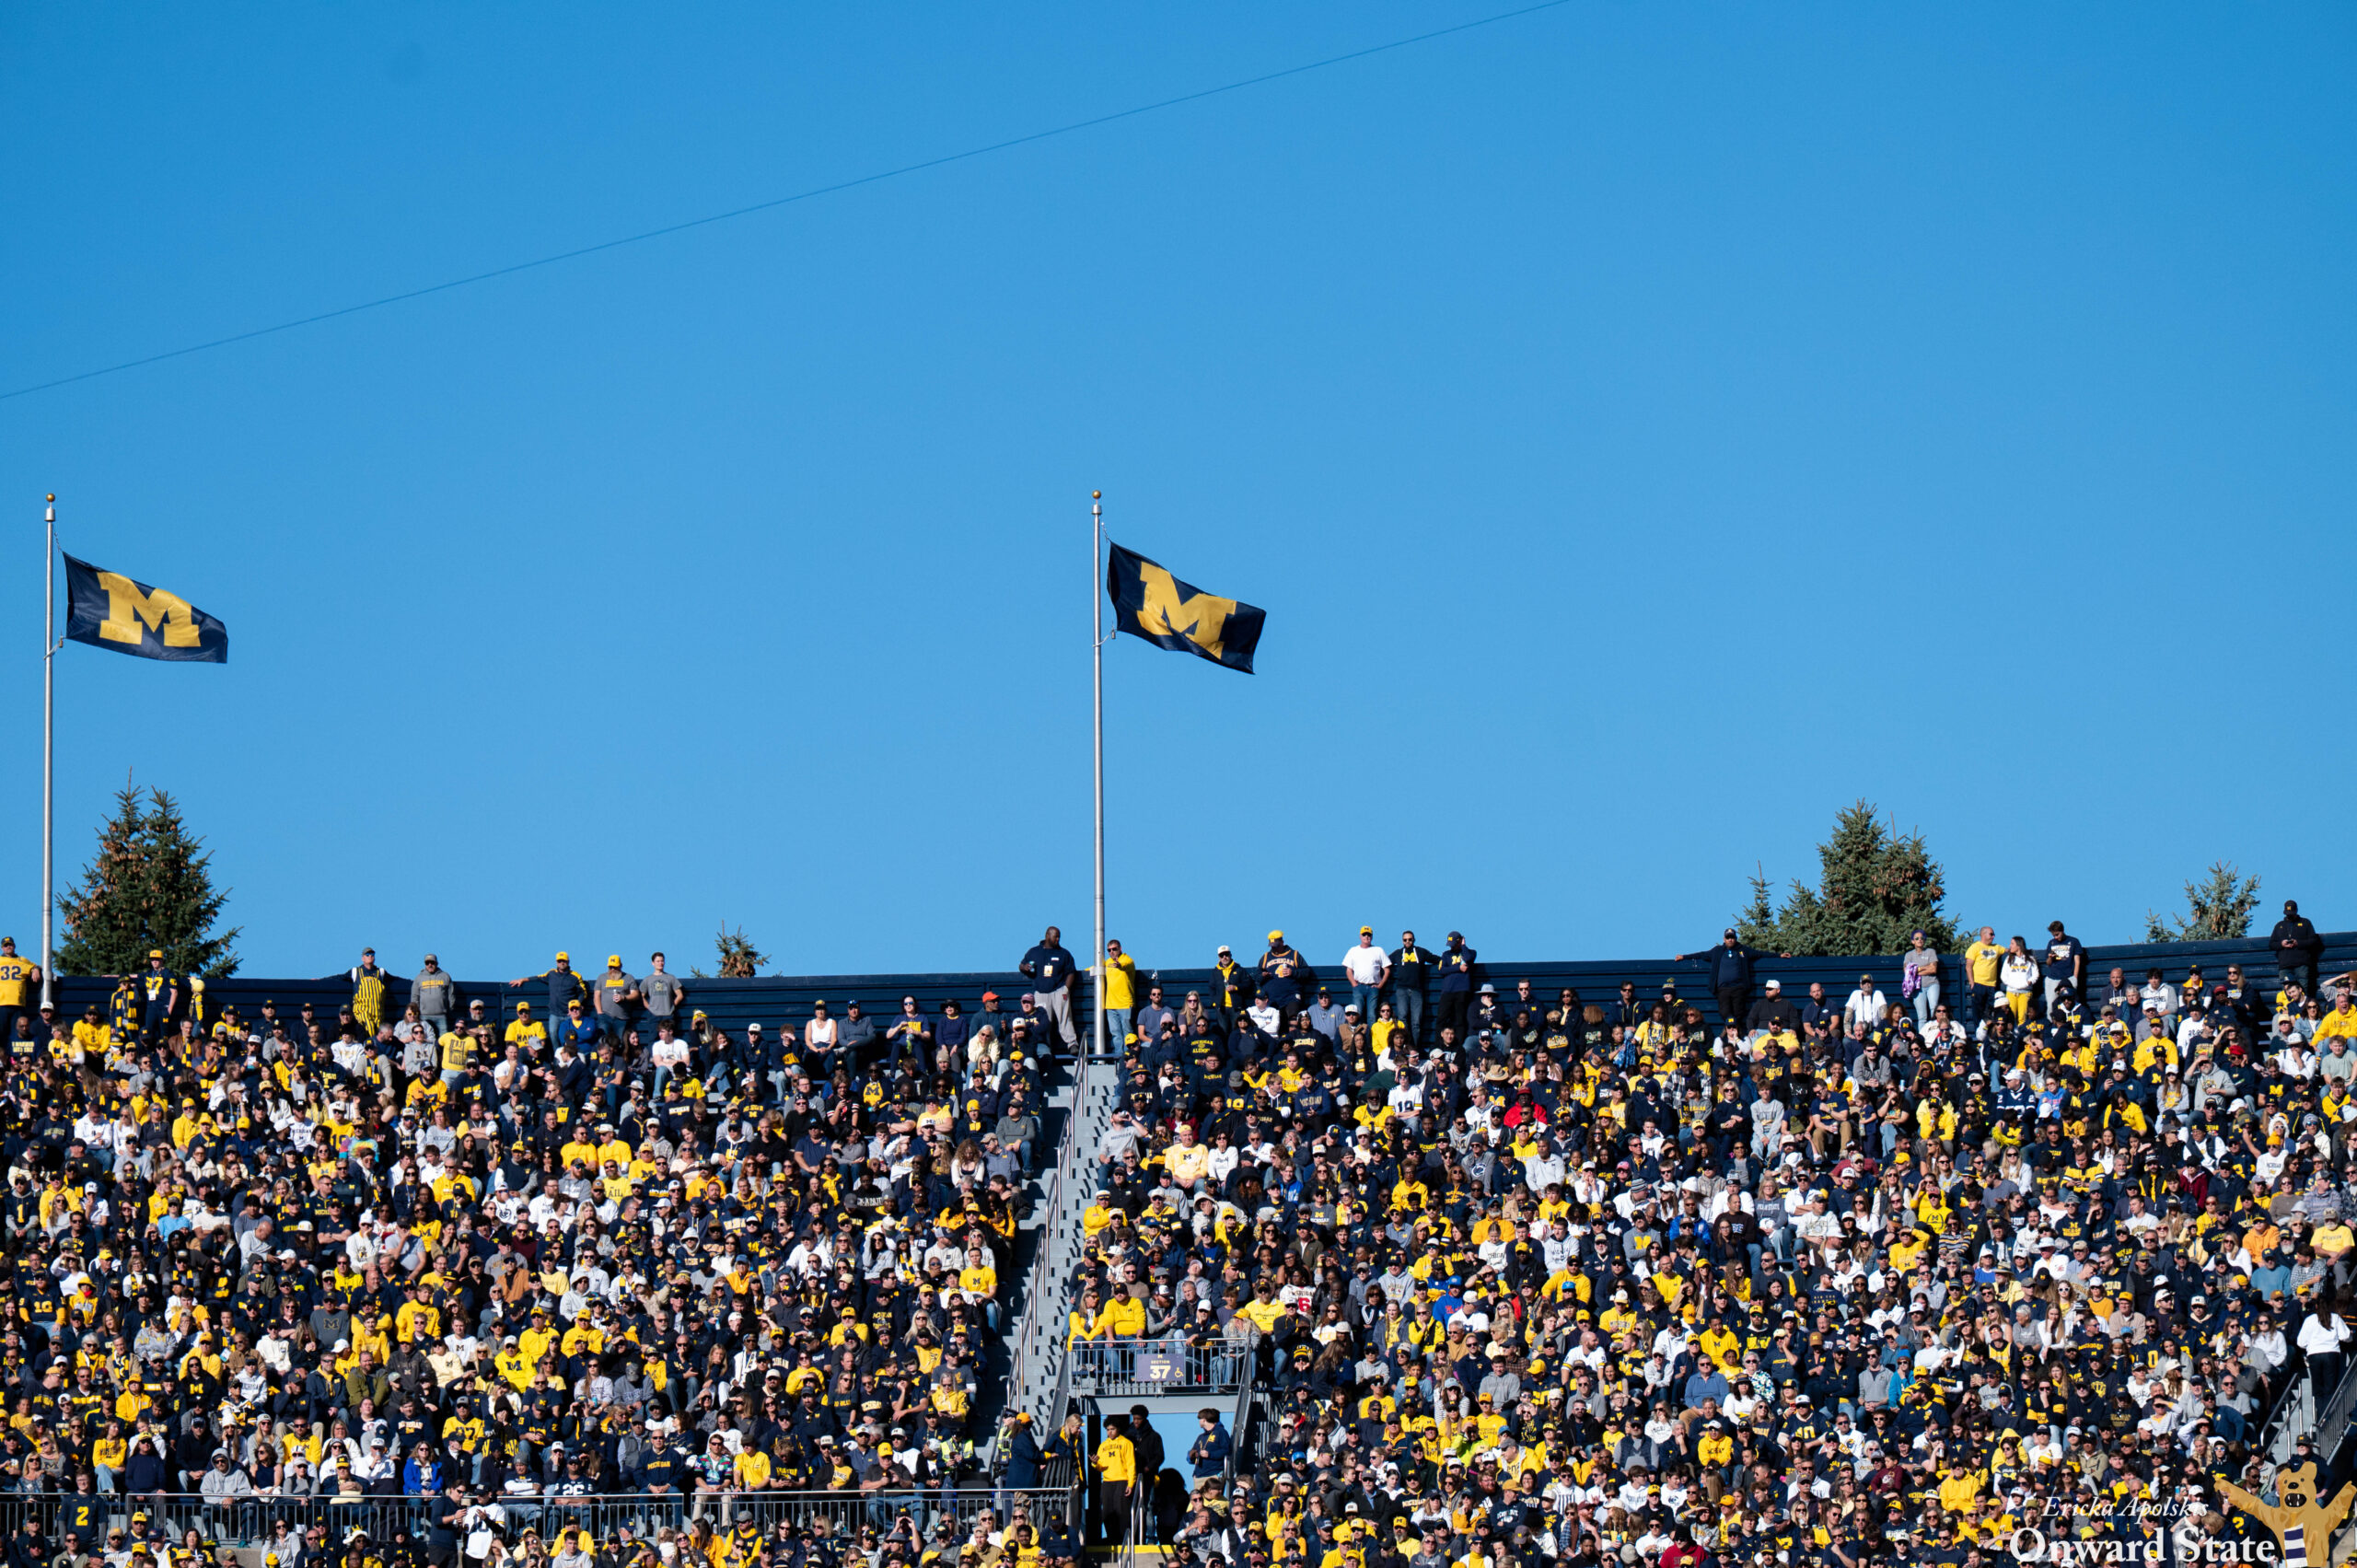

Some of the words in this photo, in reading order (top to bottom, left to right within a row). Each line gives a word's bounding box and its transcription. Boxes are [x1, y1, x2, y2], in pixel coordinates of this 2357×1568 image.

[96, 571, 202, 647] M
[1136, 561, 1237, 660] M
[1266, 958, 1294, 969] MICHIGAN
[1402, 954, 1417, 963] M
[0, 965, 22, 981] 32
[865, 1086, 880, 1096] M
[2269, 1085, 2283, 1097] M
[2007, 1127, 2022, 1137] M
[641, 1170, 654, 1179] M
[419, 1229, 431, 1237] M
[1298, 1297, 1312, 1312] 6
[323, 1318, 340, 1330] M
[505, 1360, 524, 1372] M
[1150, 1365, 1171, 1379] 37
[647, 1460, 671, 1470] MICHIGAN
[76, 1507, 89, 1527] 2
